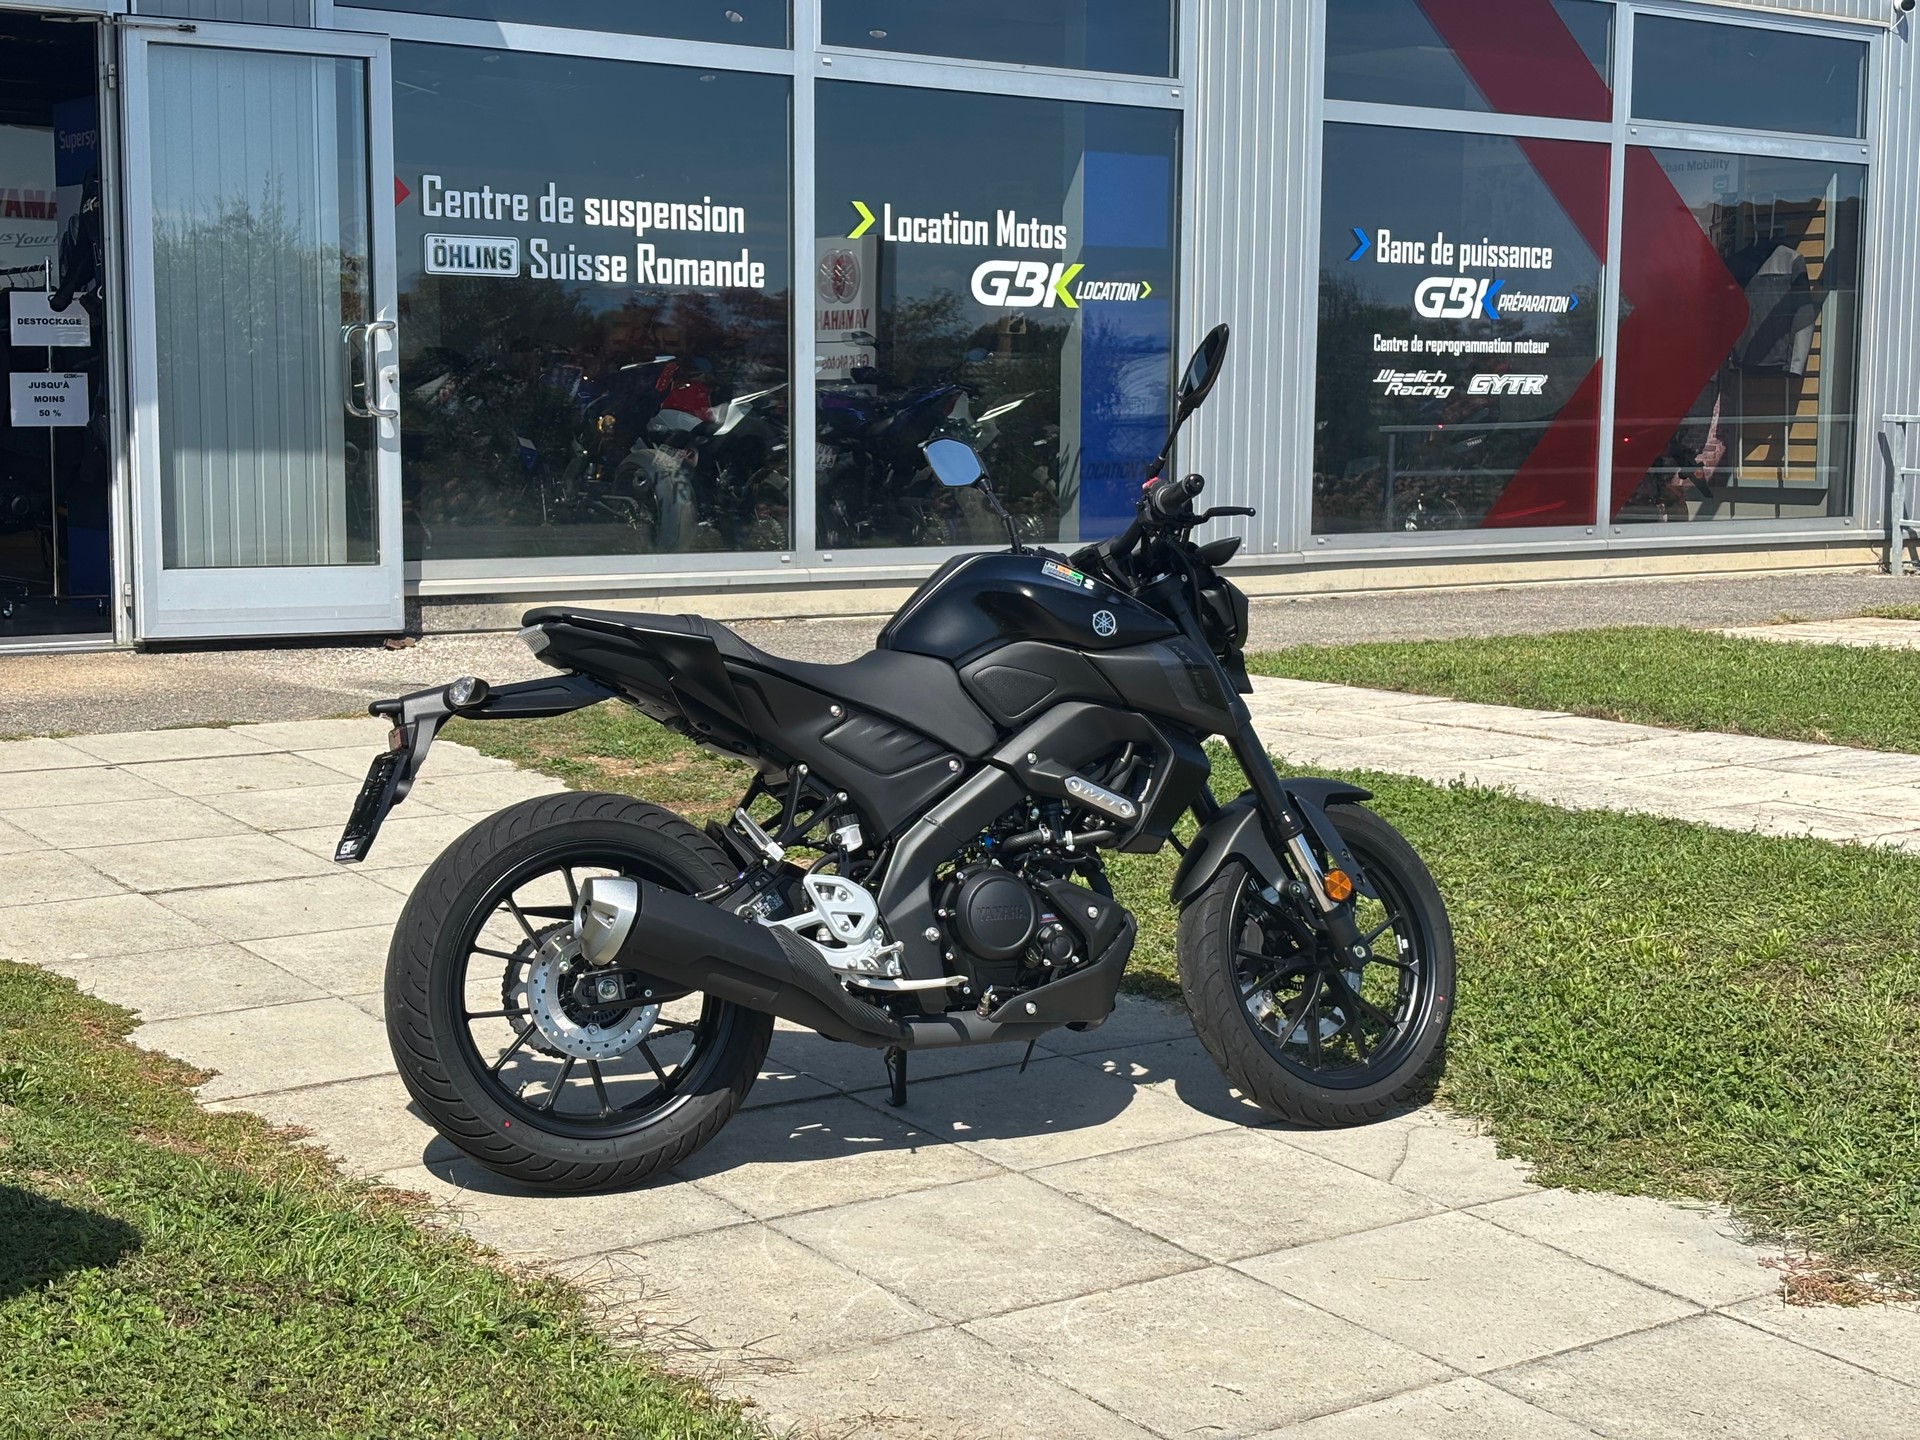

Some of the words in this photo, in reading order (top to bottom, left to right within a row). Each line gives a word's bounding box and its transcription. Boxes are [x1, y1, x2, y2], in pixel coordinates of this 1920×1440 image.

[1687, 158, 1730, 171] Mobility
[422, 174, 529, 222] Centre
[539, 182, 574, 224] de
[584, 196, 745, 237] suspension
[884, 203, 989, 246] Location
[996, 209, 1067, 250] Motos
[433, 238, 513, 270] ÖHLINS
[1376, 228, 1425, 265] Banc
[1430, 231, 1454, 266] de
[1459, 237, 1553, 274] puissance
[530, 238, 627, 284] Suisse
[636, 243, 765, 289] Romande
[970, 259, 1085, 309] GBK
[1076, 280, 1140, 301] LOCATION
[1414, 276, 1505, 320] GBK
[1497, 291, 1570, 313] PRÉPARATION
[17, 317, 82, 326] DESTOCKAGE
[1373, 333, 1409, 352] Centre
[1410, 334, 1423, 352] de
[1425, 337, 1512, 357] reprogrammation
[1514, 339, 1550, 355] moteur
[28, 380, 70, 389] JUSQU'À
[1372, 369, 1447, 383] Woolich
[1467, 373, 1546, 395] GYTR
[34, 395, 65, 403] MOINS
[1384, 382, 1455, 399] Racing
[39, 409, 50, 417] 50
[53, 409, 61, 417] %
